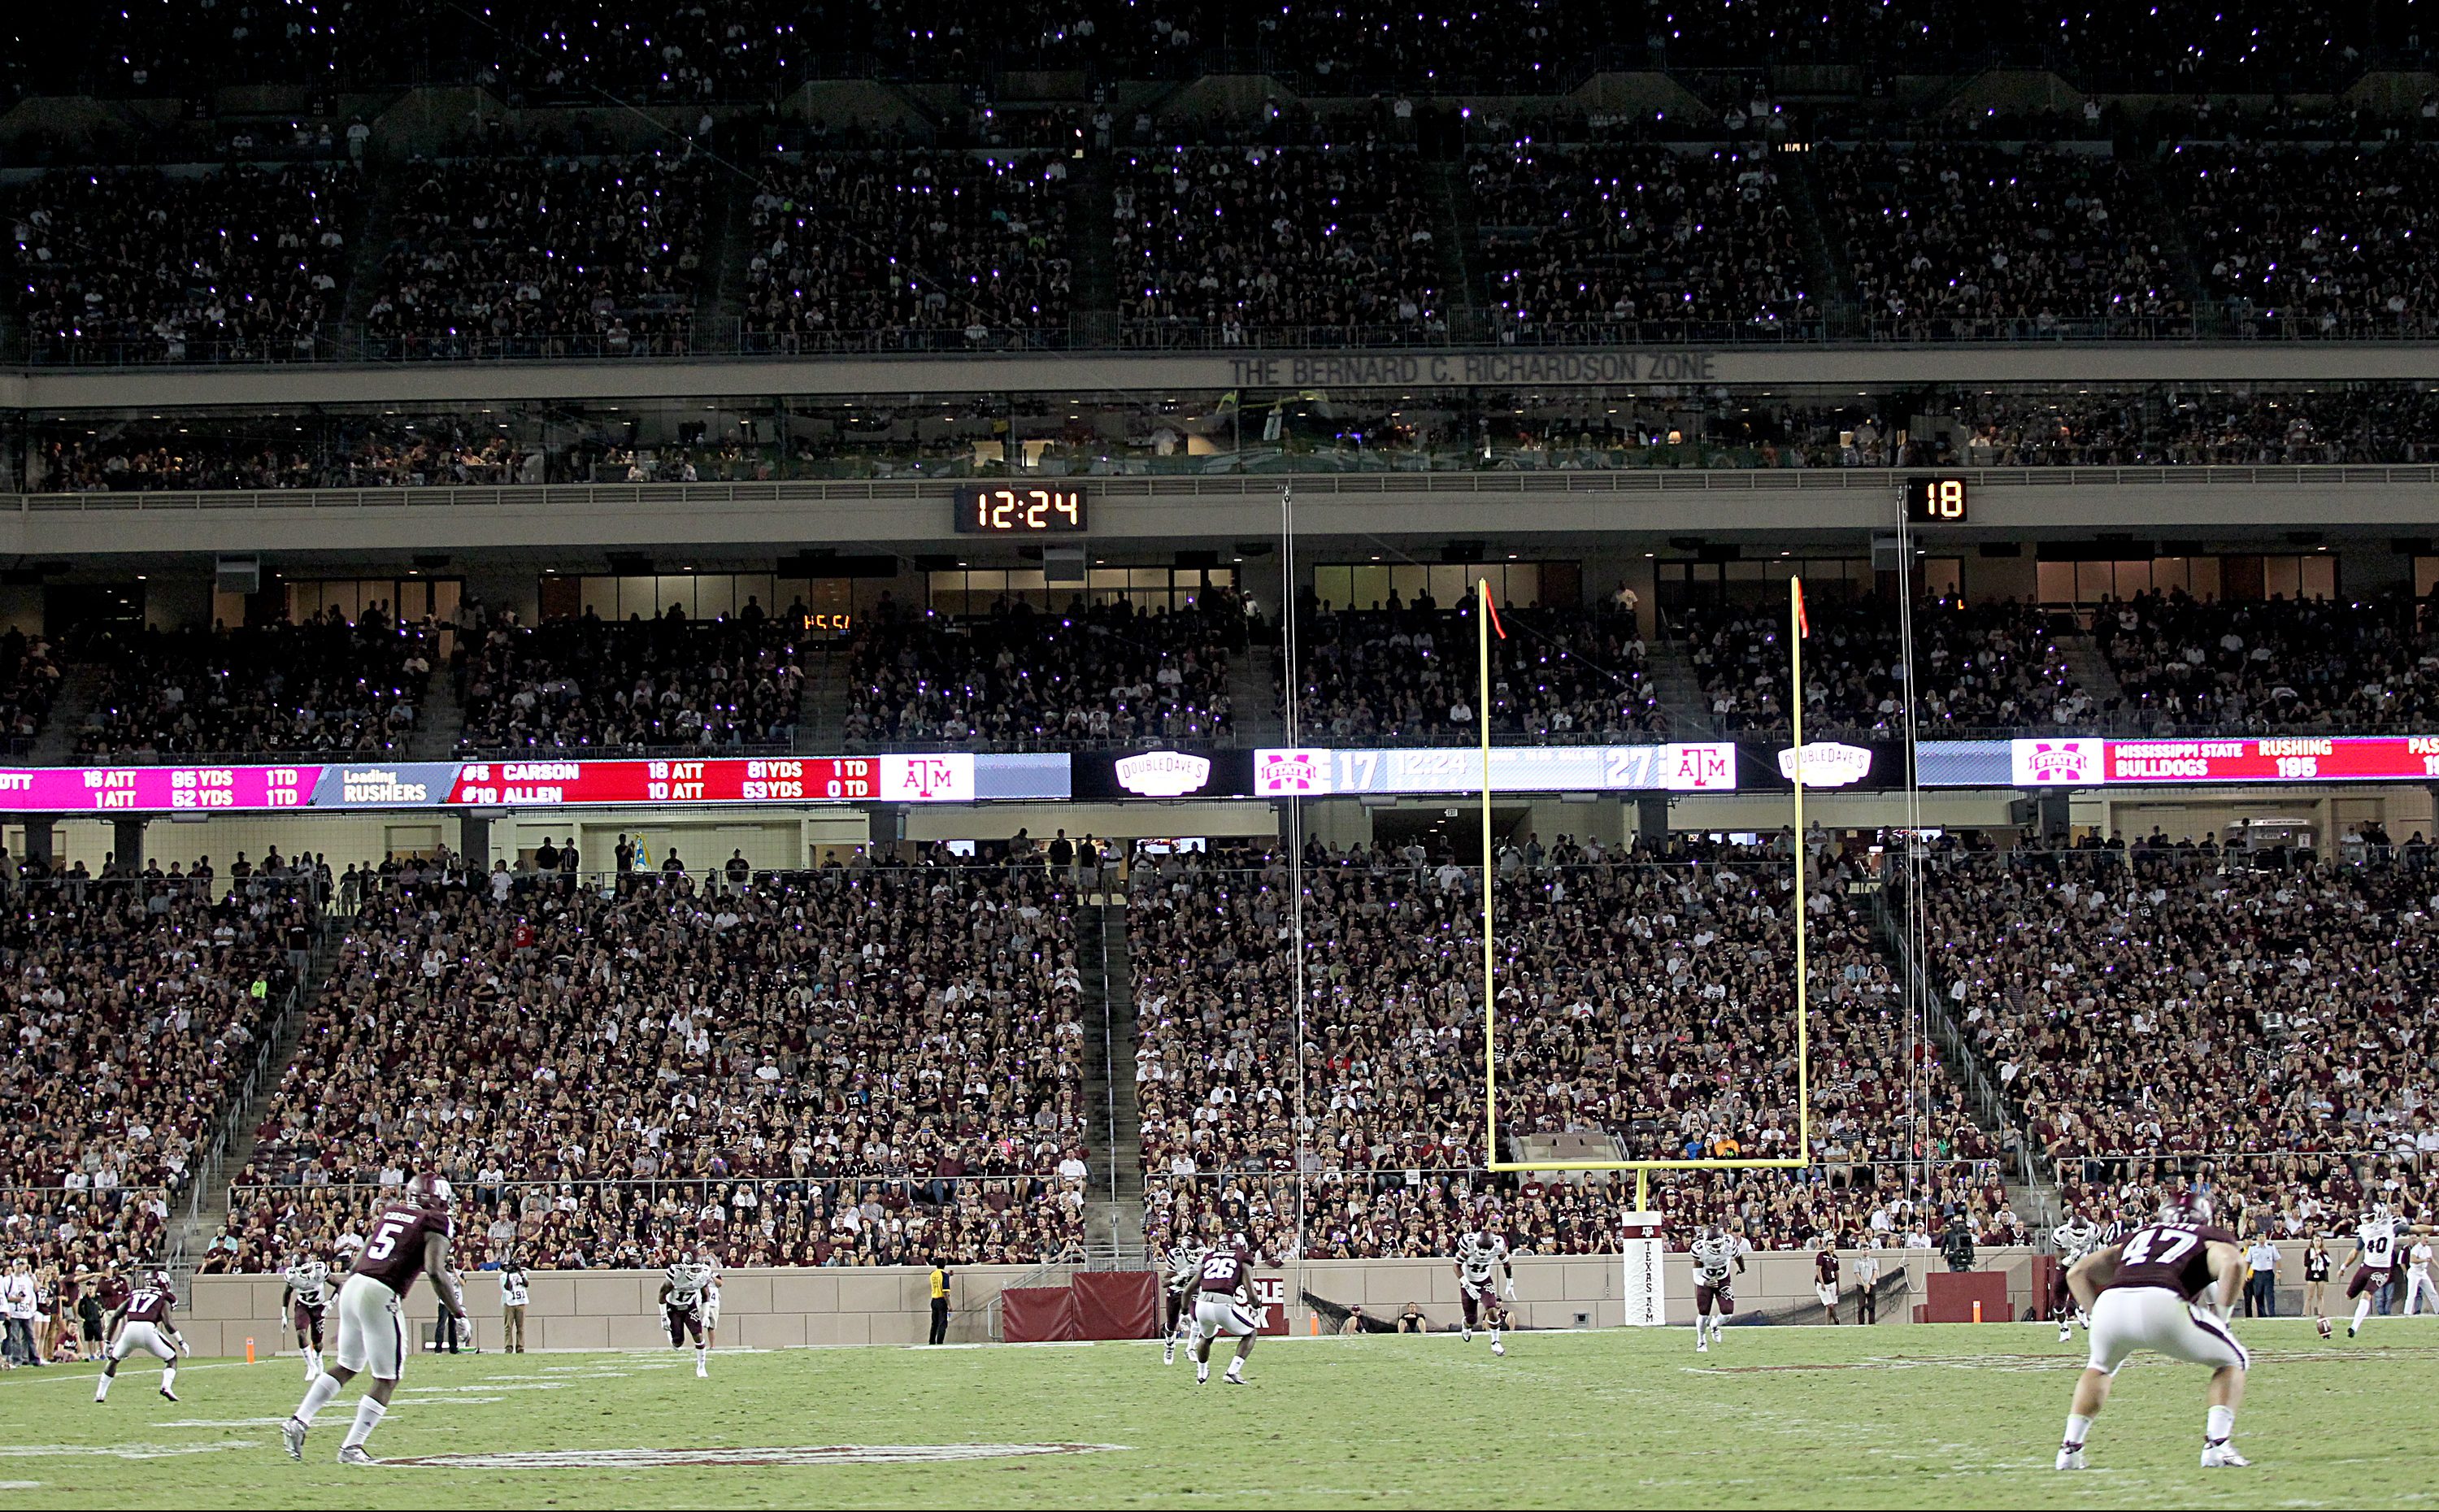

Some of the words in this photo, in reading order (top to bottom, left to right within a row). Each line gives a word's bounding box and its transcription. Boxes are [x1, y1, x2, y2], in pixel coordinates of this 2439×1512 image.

[1228, 359, 1279, 385] THE
[1293, 356, 1419, 385] BERNARD
[1432, 355, 1456, 383] C.
[1465, 353, 1637, 382] RICHARDSON
[1648, 351, 1715, 380] ZONE
[1928, 481, 1962, 517] 18
[979, 491, 1077, 528] 12:24
[2115, 744, 2199, 758] MISSISSIPPI
[2200, 743, 2244, 758] STATE
[2259, 739, 2332, 756] RUSHING
[2408, 737, 2439, 754] PAS
[463, 765, 489, 781] #5
[503, 763, 579, 780] CARSON
[648, 763, 668, 779] 18
[672, 763, 704, 779] ATT
[748, 762, 767, 778] 81
[767, 761, 802, 777] YDS
[833, 760, 841, 777] 1
[845, 760, 867, 777] TD
[1268, 763, 1311, 777] STATE
[1398, 751, 1467, 776] 12:24
[1606, 749, 1654, 788] 27
[2036, 753, 2079, 768] STATE
[2115, 758, 2208, 777] BULLDOGS
[2276, 757, 2318, 778] 195
[105, 771, 137, 788] ATT
[199, 770, 233, 787] YDS
[267, 770, 275, 786] 1
[275, 769, 298, 785] TD
[344, 769, 397, 785] Leading
[1339, 752, 1380, 791] 17
[95, 792, 103, 808] 1
[105, 791, 137, 807] ATT
[172, 790, 196, 806] 52
[198, 789, 233, 806] YDS
[267, 789, 275, 806] 1
[275, 789, 298, 805] TD
[344, 784, 427, 802] RUSHERS
[463, 786, 498, 804] #10
[503, 786, 563, 803] ALLEN
[648, 782, 668, 799] 10
[672, 782, 704, 799] ATT
[743, 781, 767, 798] 53
[767, 781, 802, 797] YDS
[828, 780, 841, 797] 0
[845, 780, 867, 797] TD
[848, 1097, 859, 1106] 12
[367, 1223, 404, 1260] 5
[2121, 1228, 2198, 1266] 47
[2367, 1236, 2388, 1253] 40
[1203, 1258, 1237, 1279] 26
[1644, 1240, 1653, 1293] TEXAS
[127, 1293, 159, 1314] 17
[511, 1290, 526, 1300] 191
[676, 1291, 696, 1302] 17
